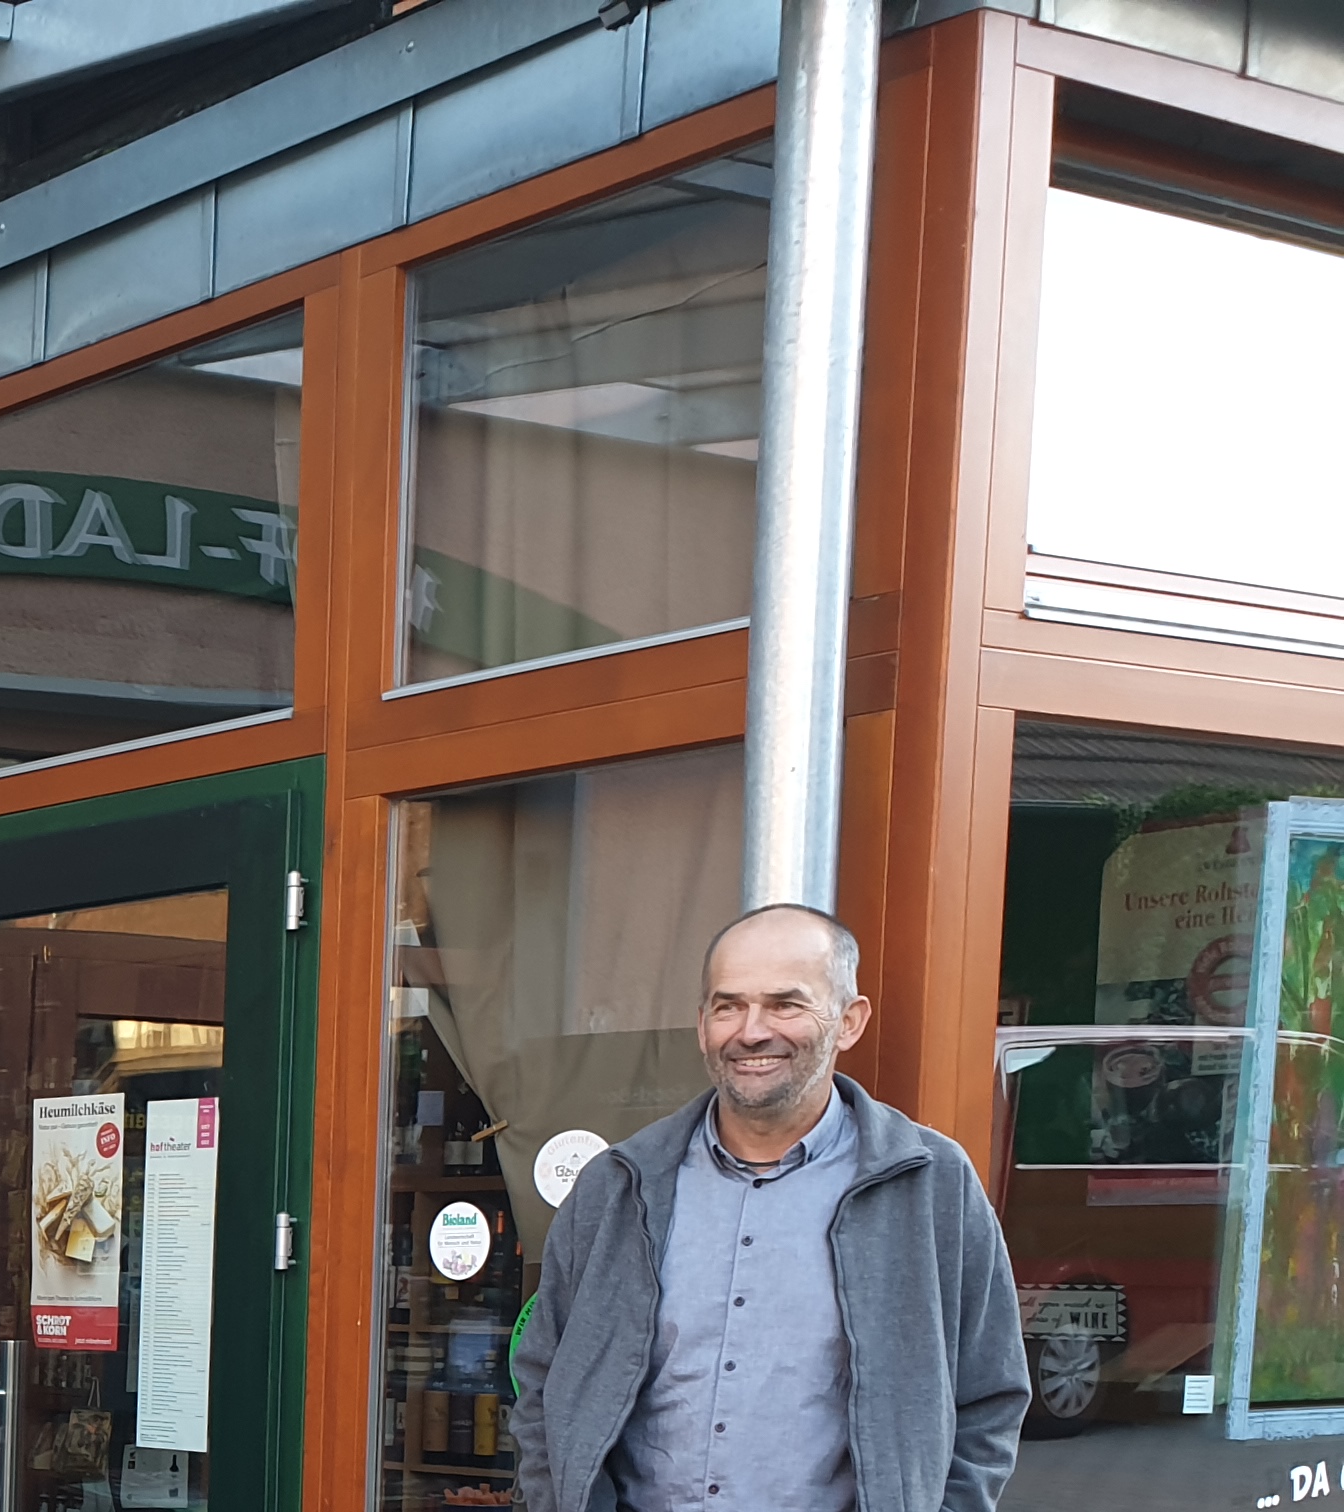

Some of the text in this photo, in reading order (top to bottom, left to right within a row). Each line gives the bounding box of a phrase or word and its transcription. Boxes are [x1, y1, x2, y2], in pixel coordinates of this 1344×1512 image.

[39, 1102, 116, 1118] Heumilchkäse
[442, 1212, 477, 1226] Bioland
[1070, 1311, 1109, 1330] WINE
[1290, 1461, 1330, 1502] DA
